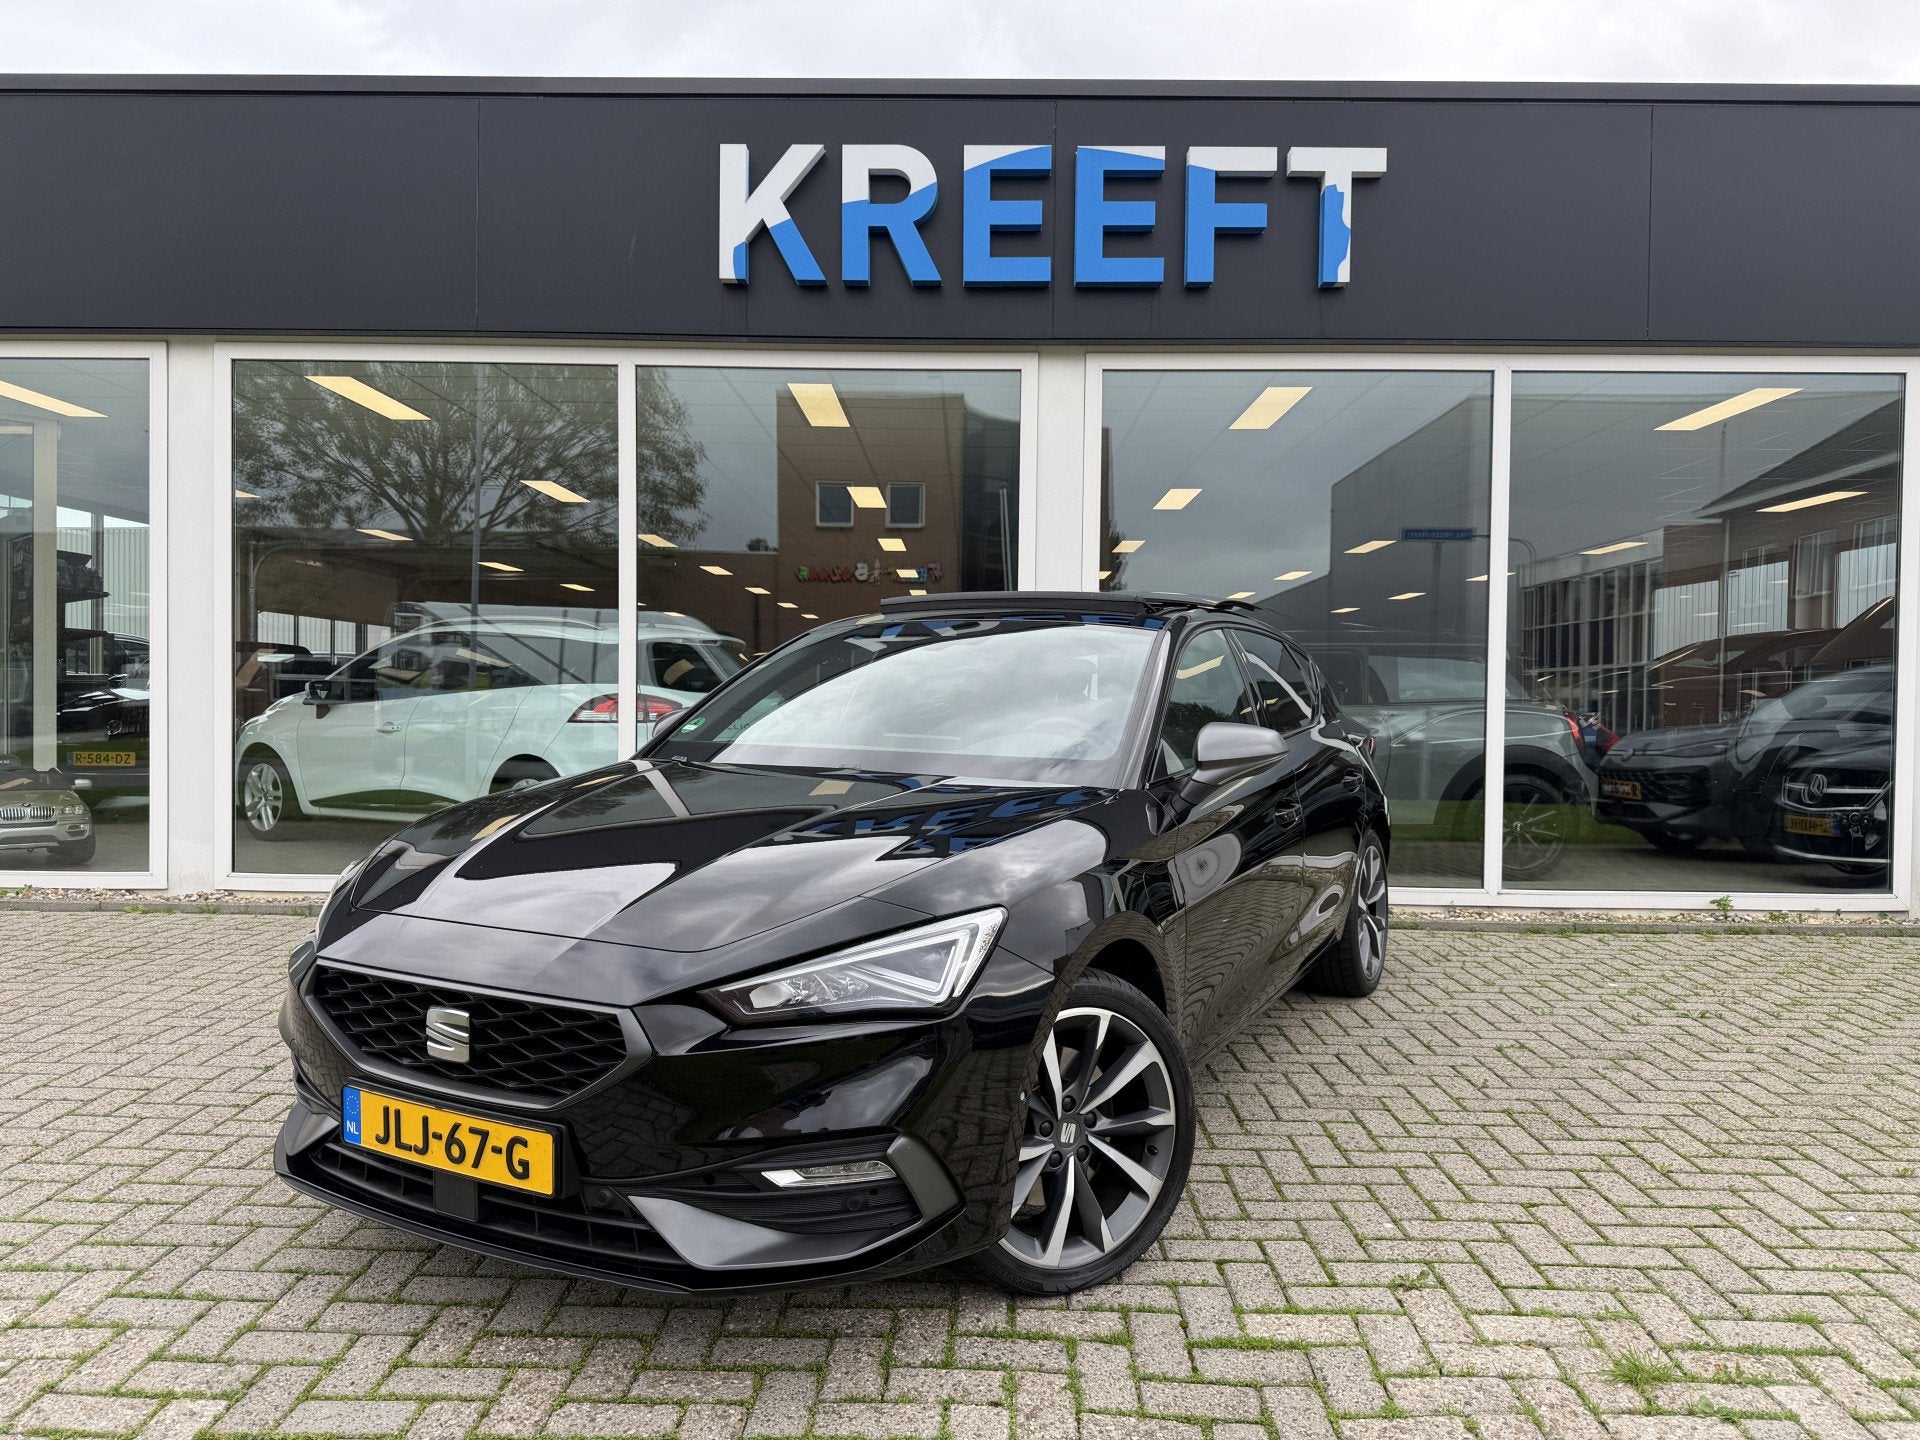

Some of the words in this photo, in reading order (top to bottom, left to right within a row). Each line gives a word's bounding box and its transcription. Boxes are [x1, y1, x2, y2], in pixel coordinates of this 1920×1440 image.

[719, 143, 1387, 288] KREEFT
[75, 753, 131, 764] R-584-DZ
[346, 1120, 359, 1135] NL
[375, 1105, 530, 1180] JLJ-67-G
